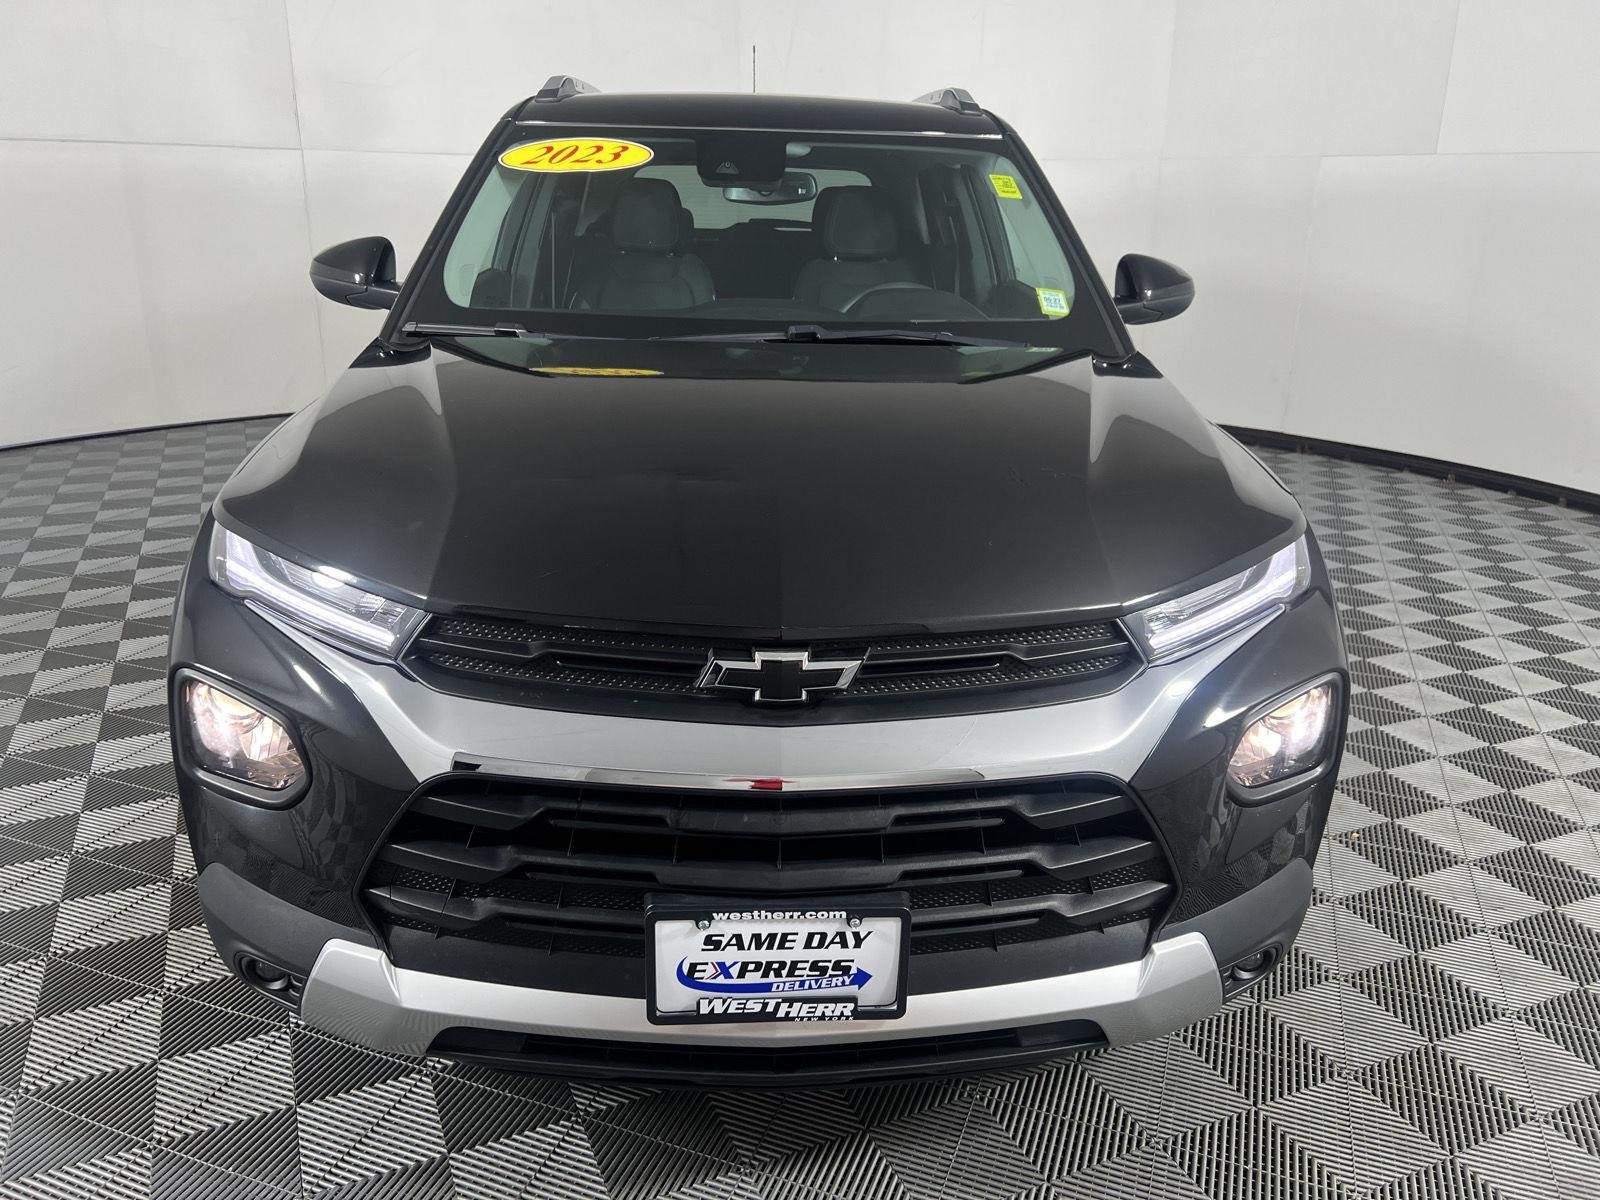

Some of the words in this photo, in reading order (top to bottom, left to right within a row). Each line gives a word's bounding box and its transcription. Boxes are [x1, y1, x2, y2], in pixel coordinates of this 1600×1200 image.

[520, 145, 628, 163] 2023
[713, 910, 846, 920] westherr.com
[701, 931, 798, 952] SAME
[804, 930, 873, 950] DAY
[686, 959, 854, 980] EXPRESS
[771, 975, 854, 992] DELIVERY
